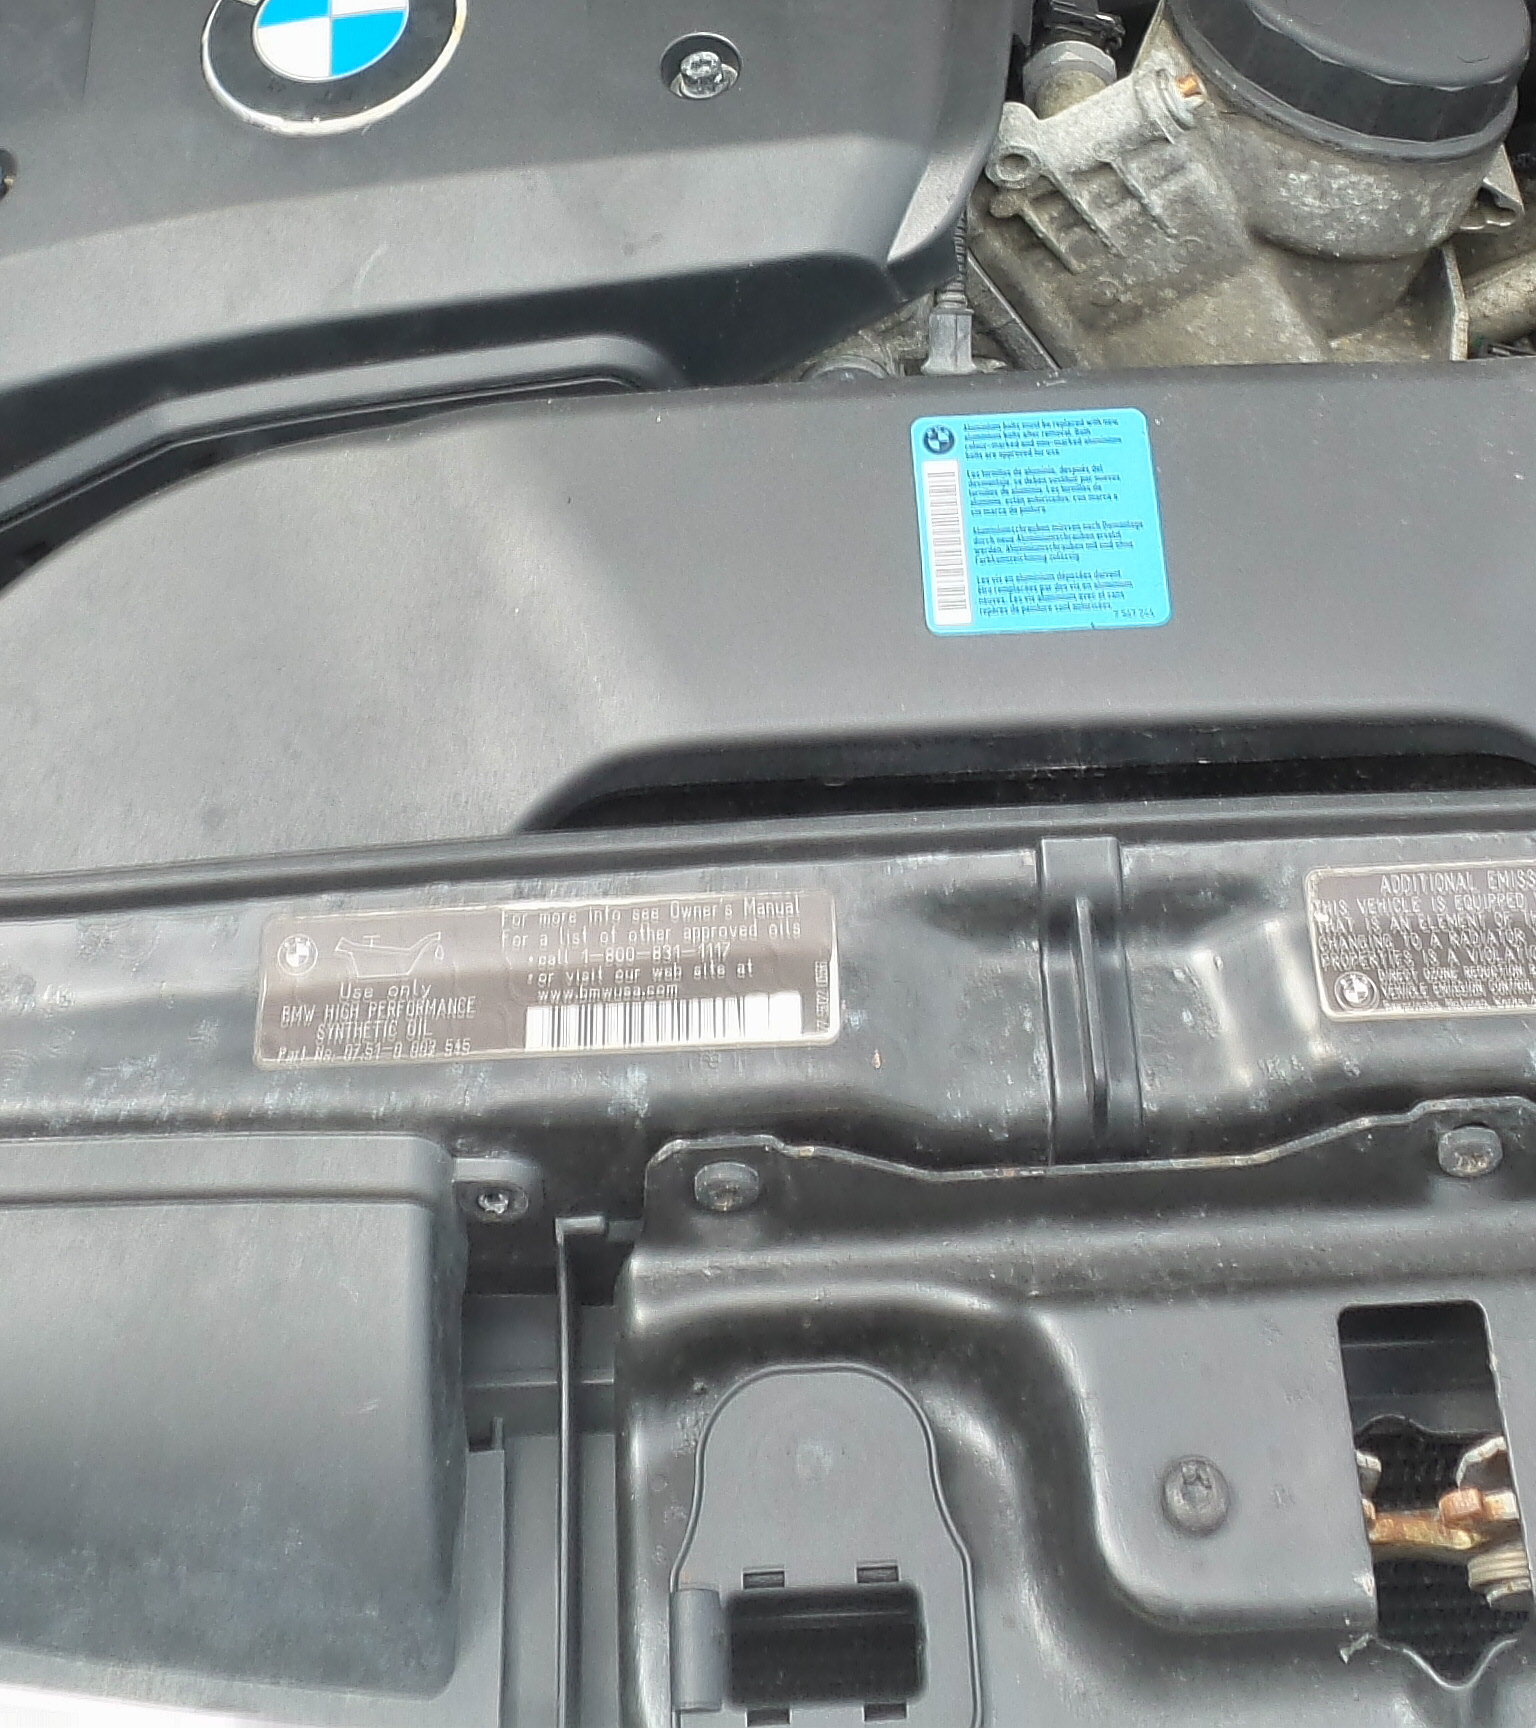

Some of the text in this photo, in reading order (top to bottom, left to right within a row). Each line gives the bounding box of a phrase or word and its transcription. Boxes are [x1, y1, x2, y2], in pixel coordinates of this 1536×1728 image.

[1380, 872, 1477, 895] ADDITIONAL
[502, 910, 527, 928] For
[539, 911, 577, 926] more
[632, 908, 659, 922] see
[670, 897, 733, 922] Owner's
[743, 894, 800, 919] Manual
[1314, 899, 1348, 915] THIS
[1357, 895, 1421, 915] VEHICLE
[1432, 895, 1447, 912] IS
[1455, 892, 1525, 911] EQUIPPED
[502, 917, 801, 951] For a list of other approved oils
[1366, 916, 1381, 934] IS
[1390, 915, 1412, 932] AN
[1419, 912, 1486, 932] ELEMENT
[1494, 910, 1511, 927] OF
[1319, 933, 1394, 952] CHANGING
[1403, 933, 1423, 951] TO
[1430, 933, 1443, 949] A
[1449, 927, 1526, 948] RADIATOR
[582, 940, 731, 964] 1-800-831-1117
[1321, 950, 1415, 971] PROPERTIES
[1423, 950, 1440, 967] IS
[1448, 950, 1461, 966] A
[566, 966, 603, 986] visit
[615, 968, 640, 983] our
[652, 962, 682, 981] web
[694, 960, 726, 979] site
[737, 958, 752, 978] at
[1378, 969, 1418, 984] DIRECT
[1423, 967, 1458, 983] OZONE
[1464, 964, 1525, 981] REDUCTION
[339, 978, 432, 1002] Use only
[538, 984, 678, 1003] www.bmwusa.com
[1380, 982, 1428, 1000] VEHICLE
[1433, 979, 1486, 999] EMISSION
[1488, 978, 1534, 996] CONTROL
[281, 996, 476, 1027] BMW HIGH PERFORMANCE
[316, 1018, 433, 1044] SYNTHETIC OIL
